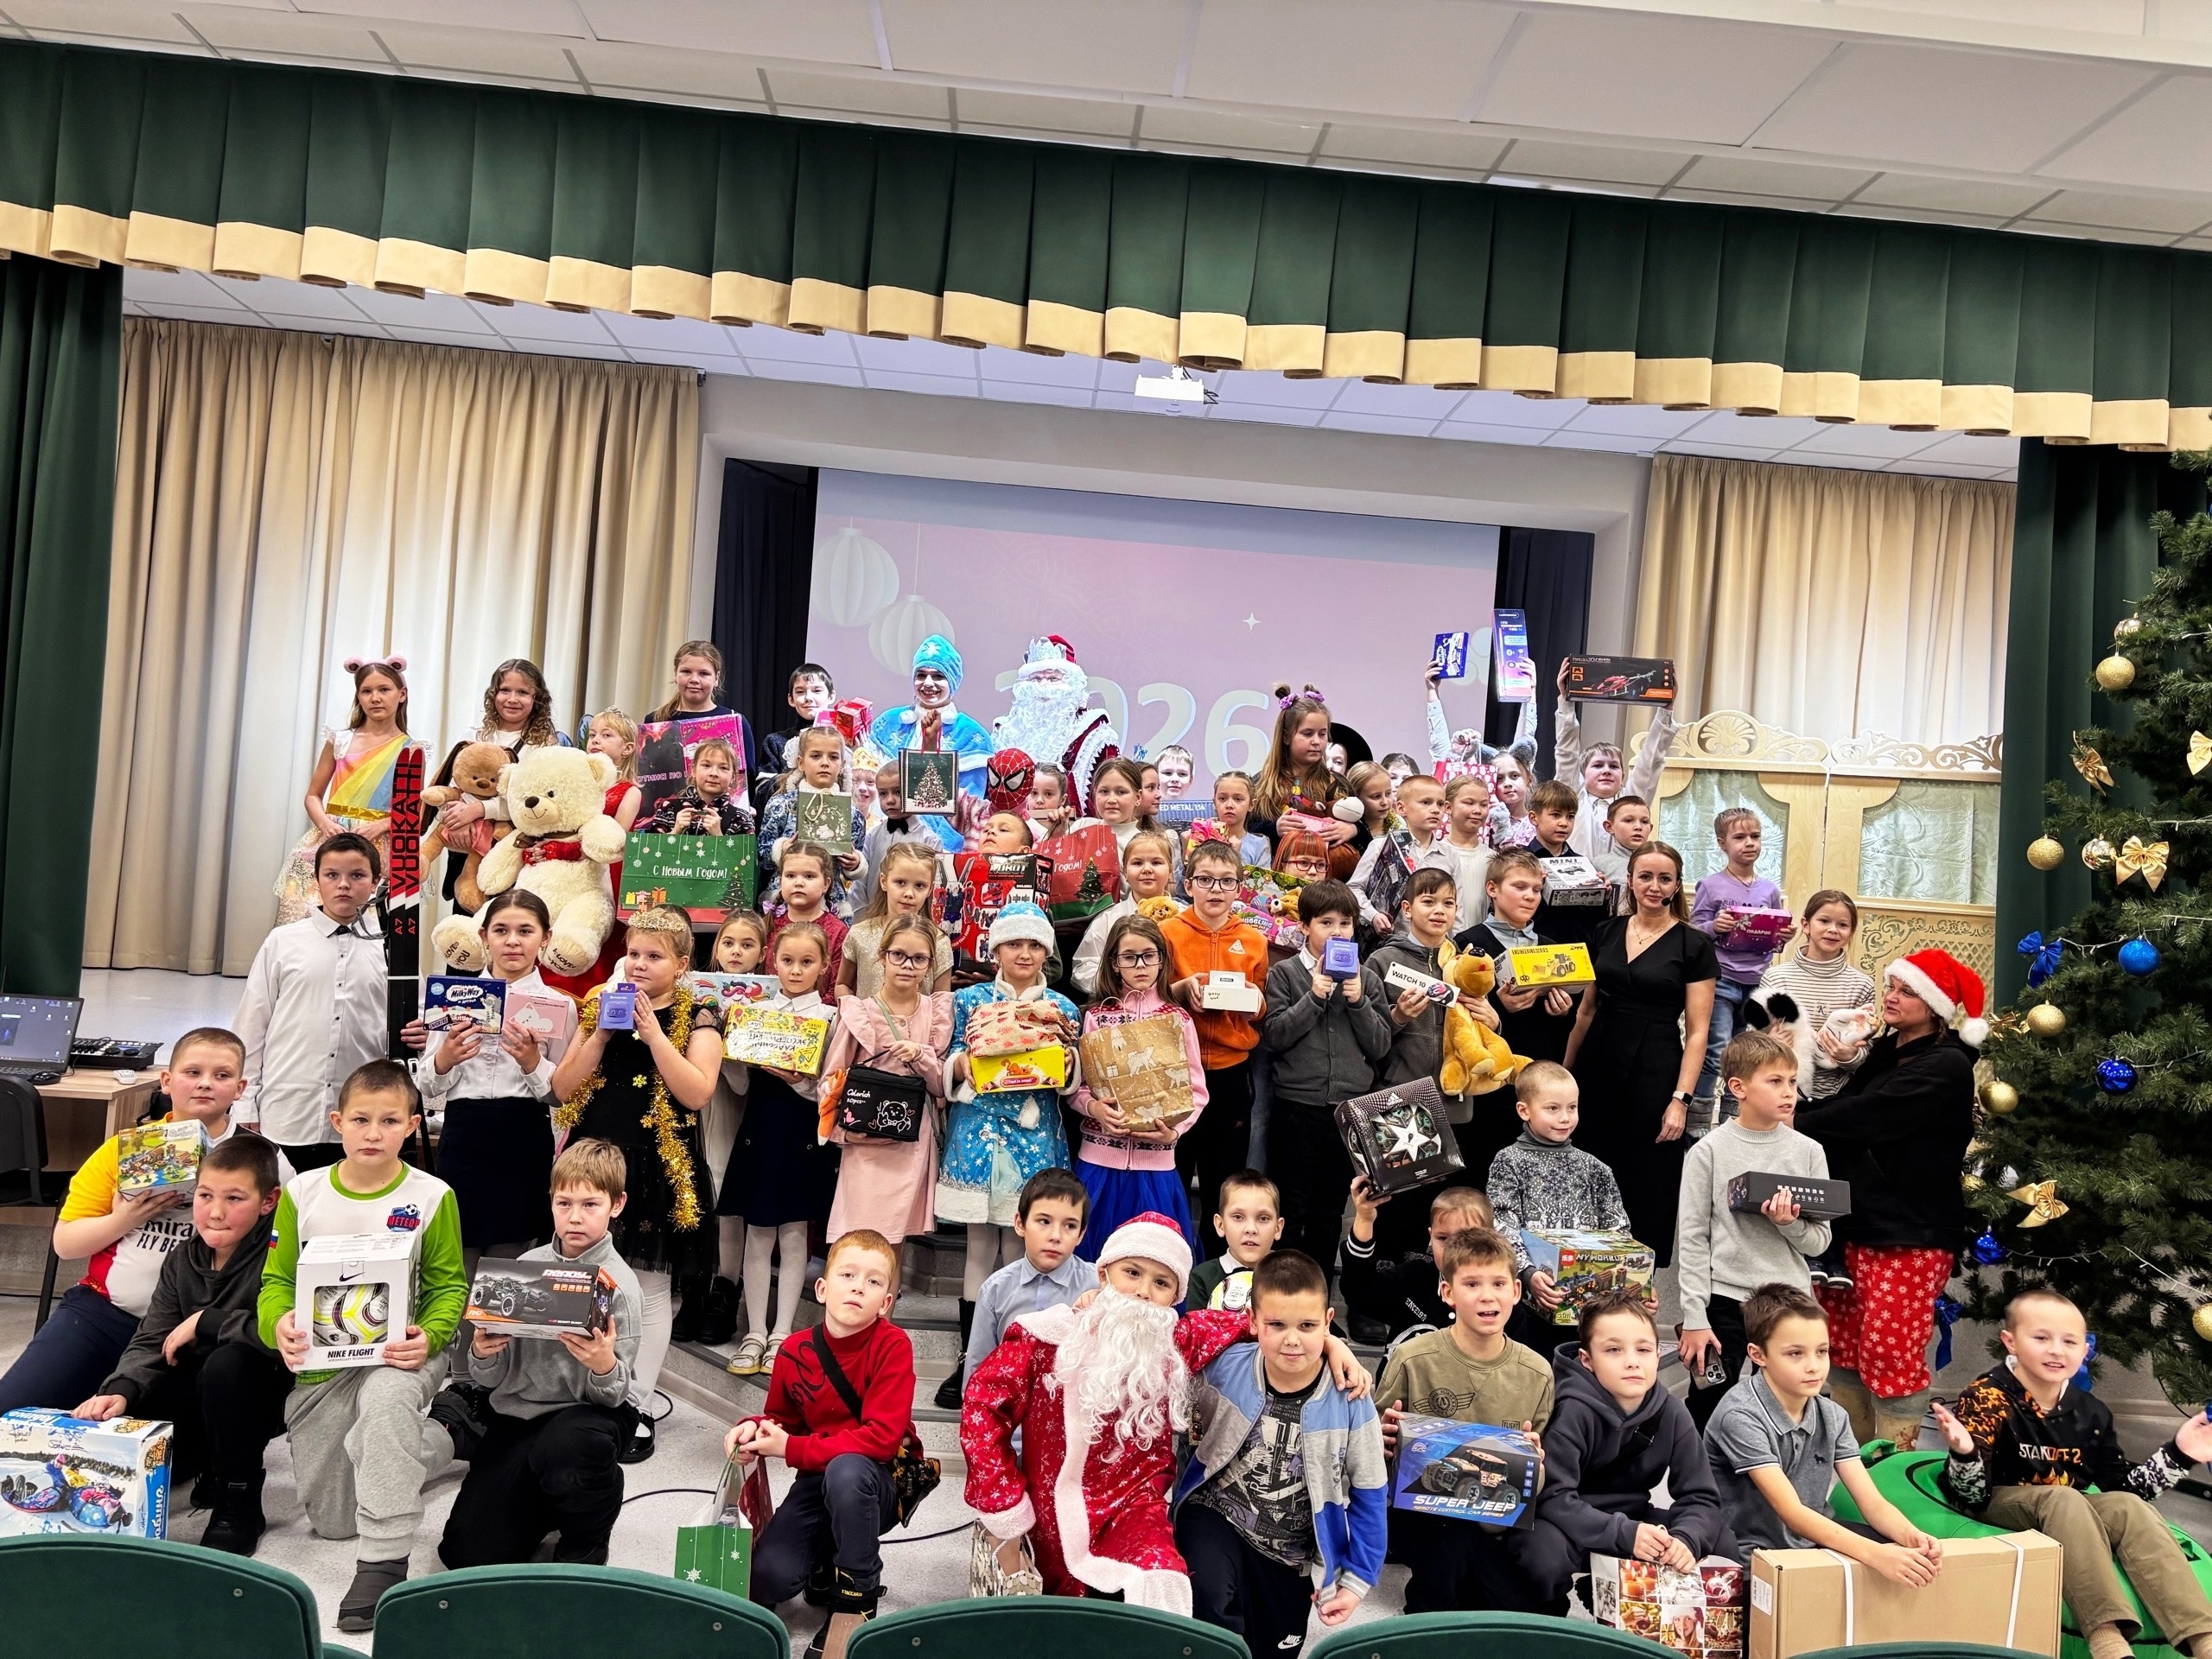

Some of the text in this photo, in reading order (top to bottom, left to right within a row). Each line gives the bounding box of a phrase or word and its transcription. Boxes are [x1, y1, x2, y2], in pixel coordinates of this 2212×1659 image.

[391, 763, 410, 891] VUOKATTI
[405, 764, 422, 891] VUOKATTI
[662, 865, 692, 877] Новым
[696, 867, 728, 880] Годом!
[395, 918, 404, 935] A7
[409, 918, 416, 935] A7
[1392, 969, 1418, 985] WATCH
[143, 1217, 194, 1237] mira
[137, 1233, 178, 1252] FLY BE
[327, 1348, 375, 1358] NIKE FLIGHT
[2071, 1448, 2082, 1464] 2
[1413, 1495, 1516, 1512] SUPER JEEP
